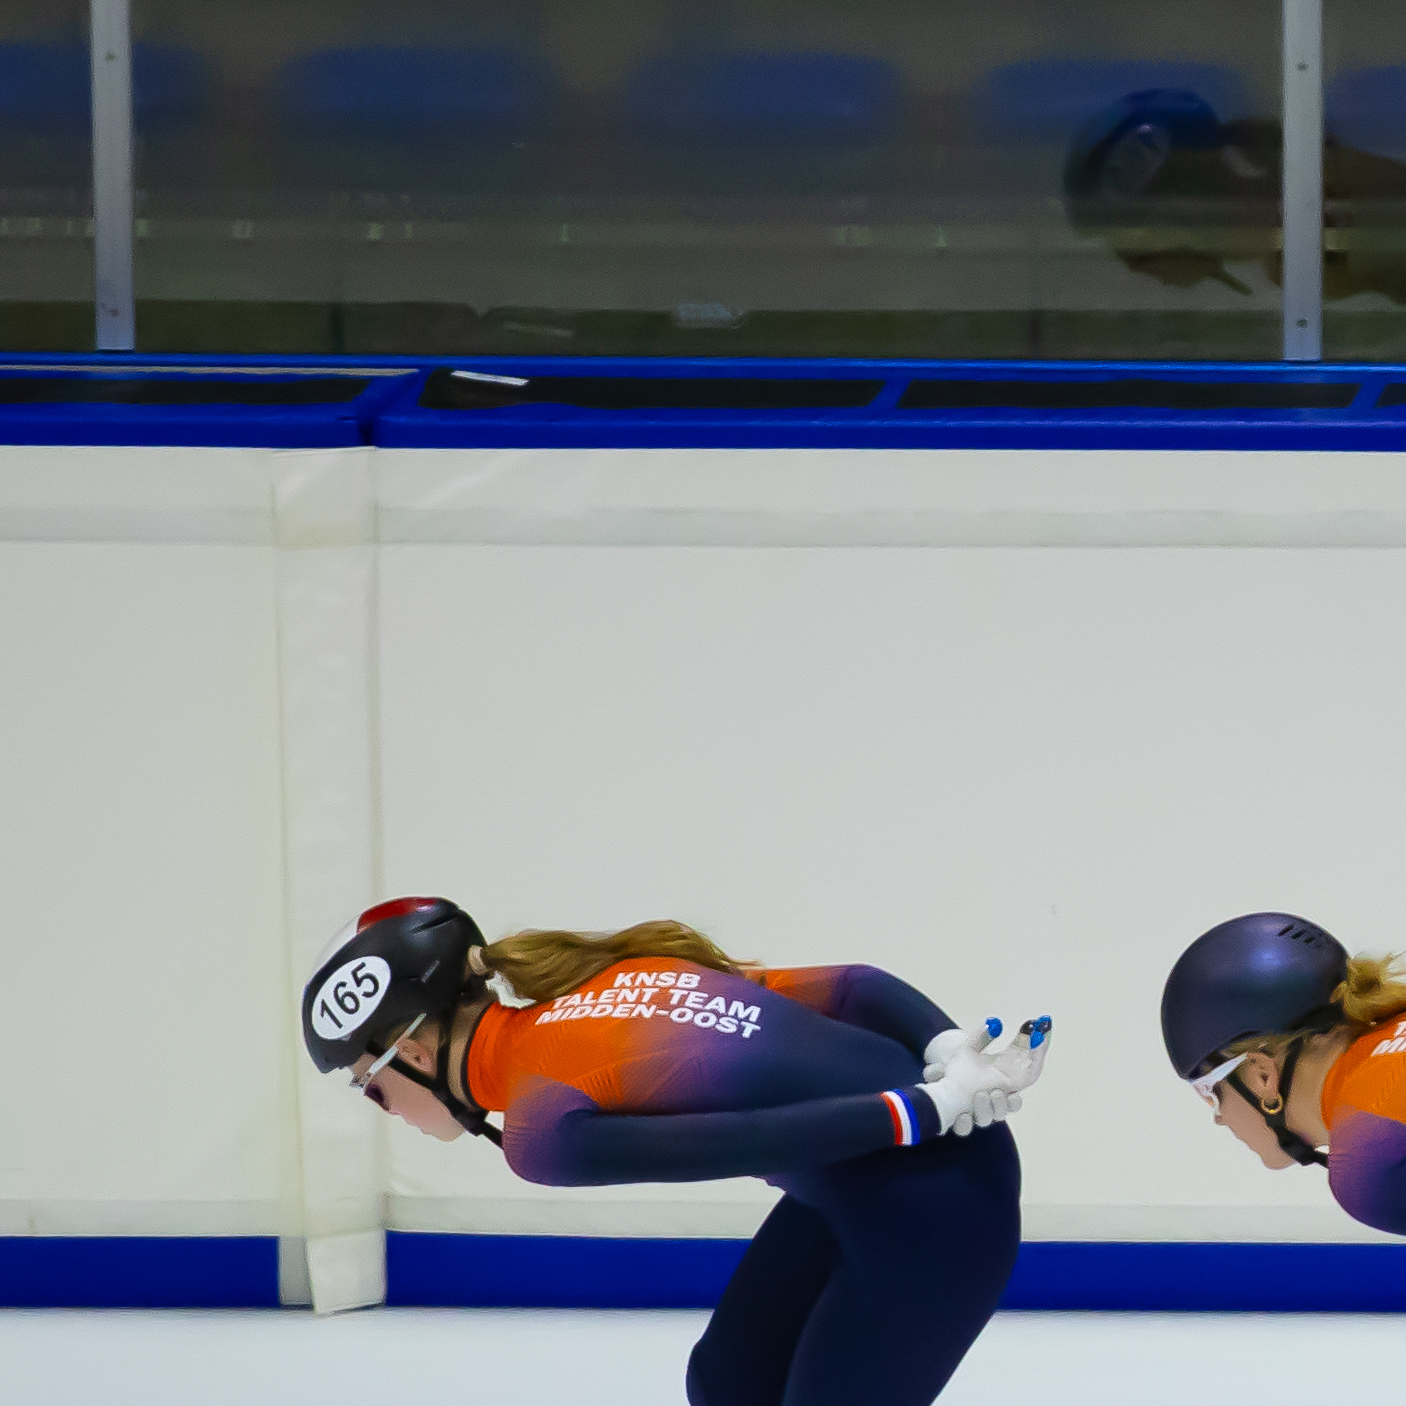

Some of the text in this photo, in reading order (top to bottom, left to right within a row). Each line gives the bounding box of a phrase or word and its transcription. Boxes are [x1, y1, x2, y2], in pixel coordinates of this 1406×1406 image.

[320, 961, 380, 1029] 165
[612, 971, 701, 989] KNSB
[535, 1003, 761, 1038] MIDDEN-OOST
[552, 987, 762, 1023] TALENT TEAM
